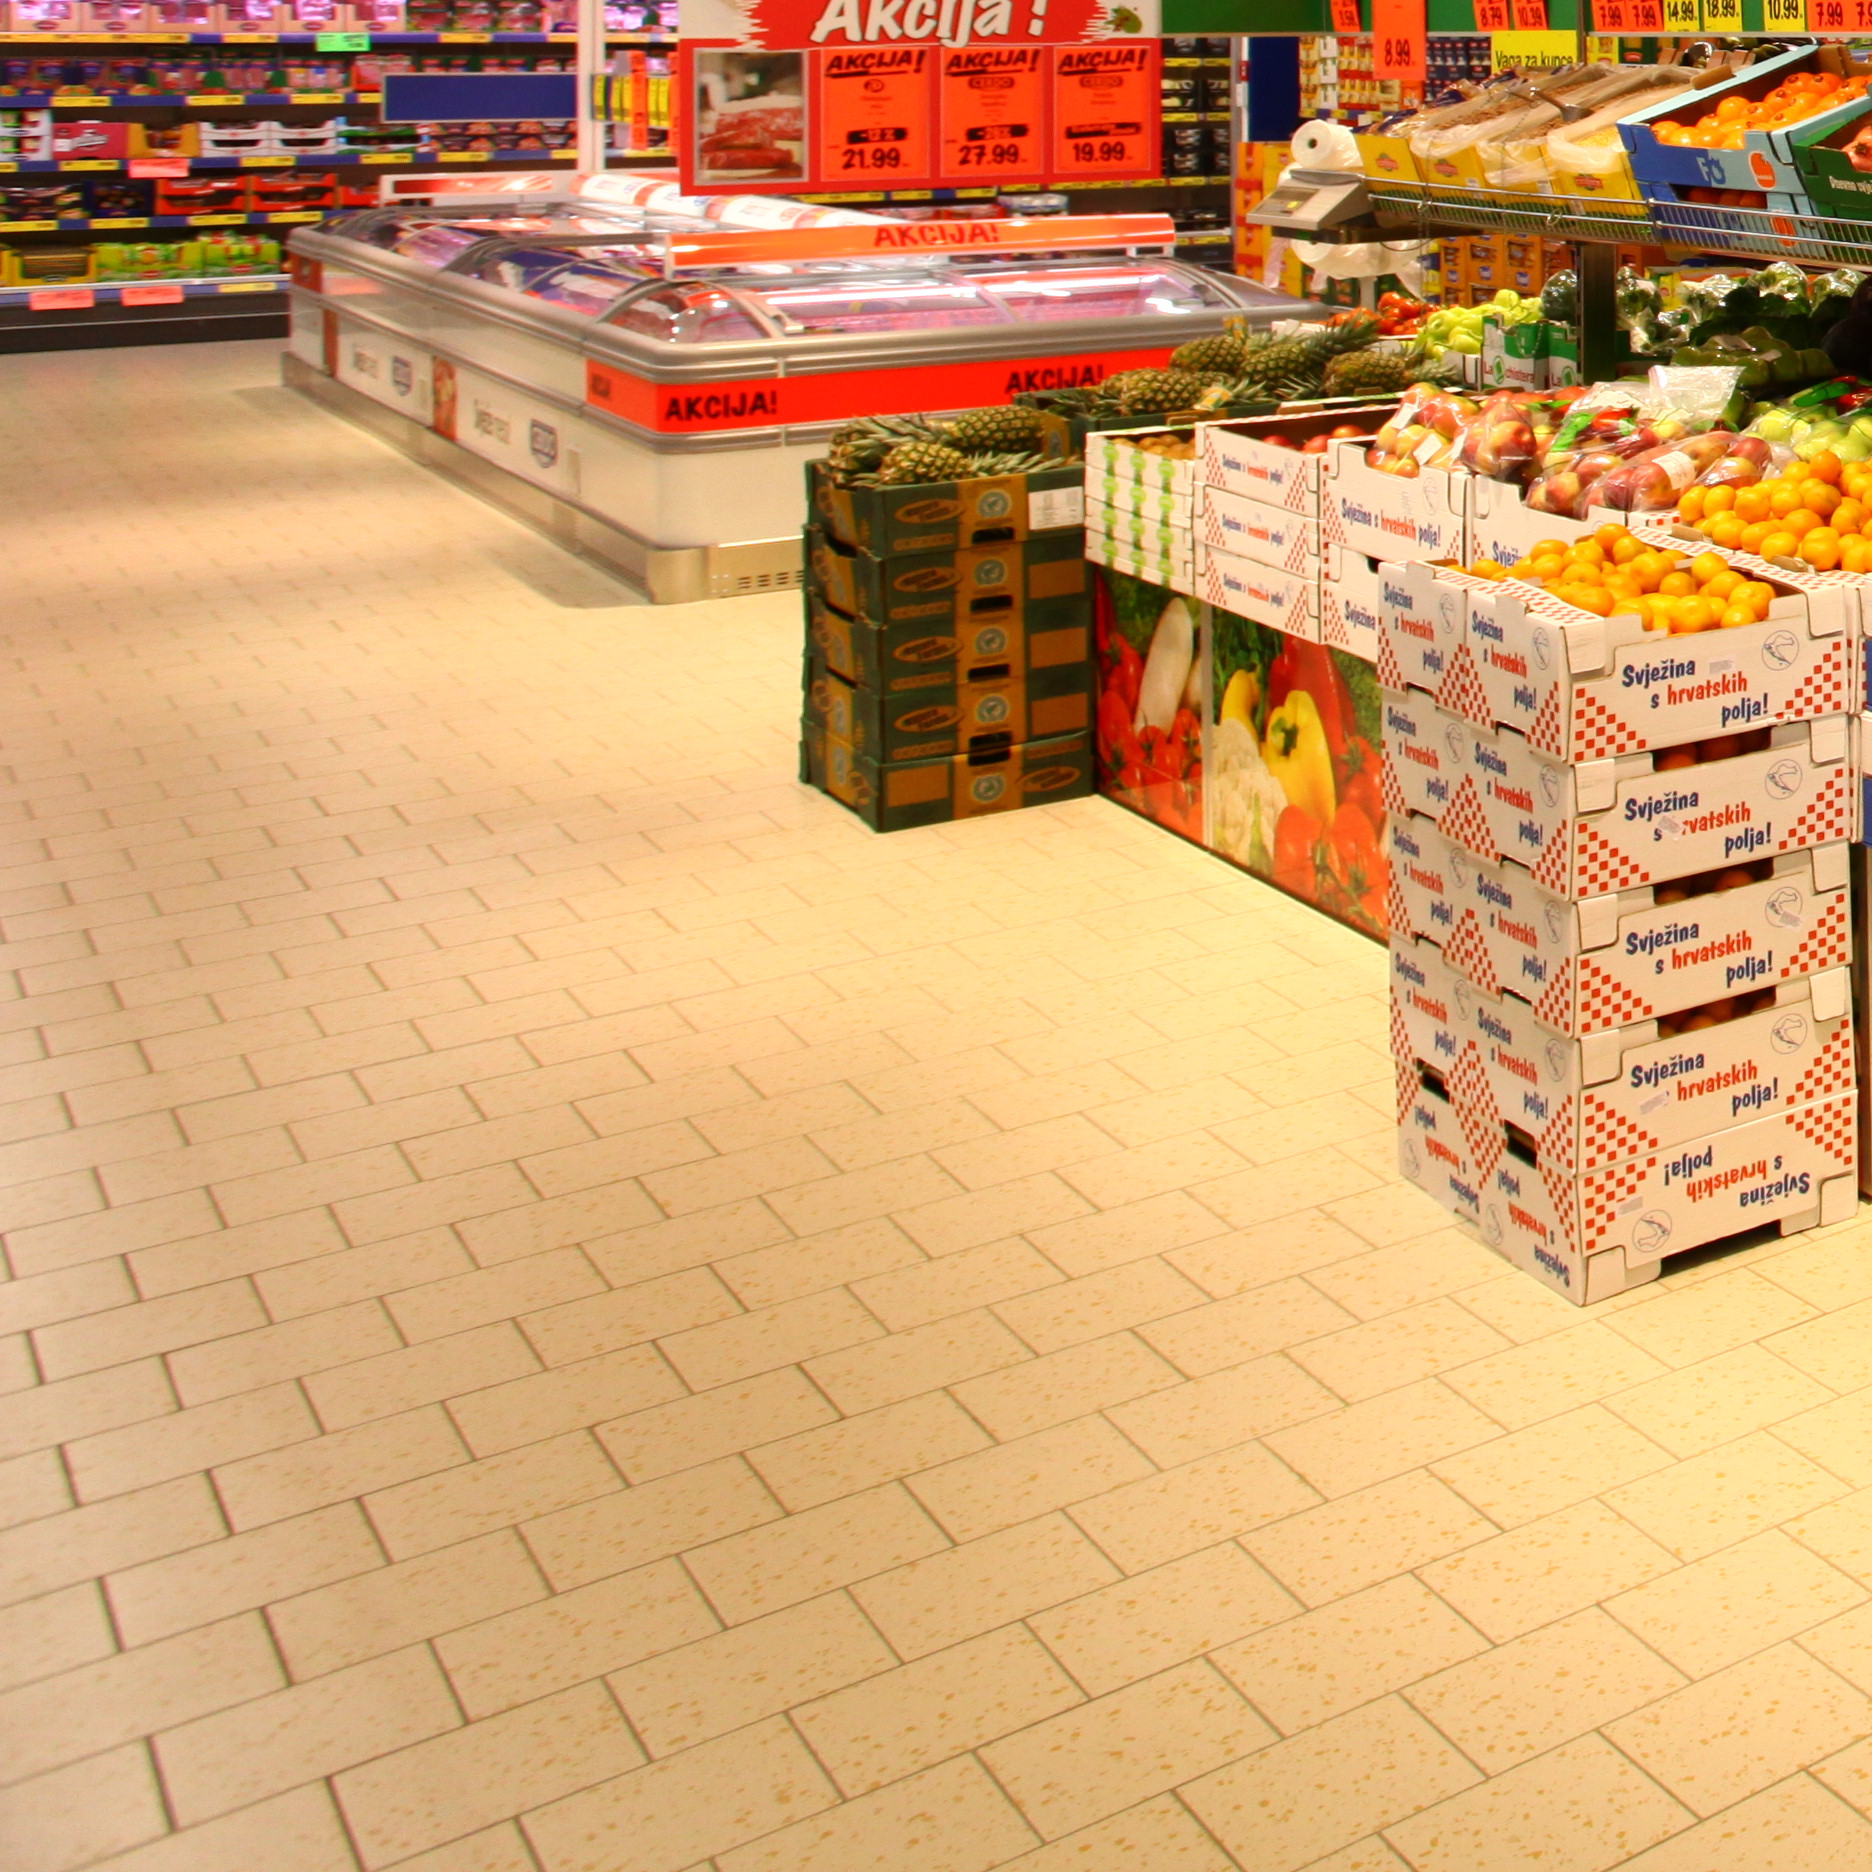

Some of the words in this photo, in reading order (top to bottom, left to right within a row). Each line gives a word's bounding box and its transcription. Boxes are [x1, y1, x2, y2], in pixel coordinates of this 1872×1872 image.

[1667, 1, 1694, 22] 14.99
[826, 50, 926, 73] AKCIJA!
[947, 49, 1041, 72] AKCIJA!
[1385, 38, 1410, 66] 8.99
[1525, 54, 1537, 65] za
[842, 148, 901, 169] 21.99
[958, 144, 1019, 166] 27.99
[874, 220, 999, 249] AKCIJA!
[666, 390, 778, 422] AKCIJA!
[1341, 497, 1372, 527] Svježina
[1381, 509, 1416, 540] hrvatskih
[1418, 525, 1440, 551] polja!
[1622, 658, 1696, 689] Svježina
[1651, 694, 1660, 709] s
[1668, 671, 1747, 705] hrvatskih
[1722, 693, 1768, 728] polja!
[1664, 1145, 1713, 1186] polja!
[1686, 1160, 1766, 1203] hrvatskih
[1740, 1172, 1810, 1207] Svježina
